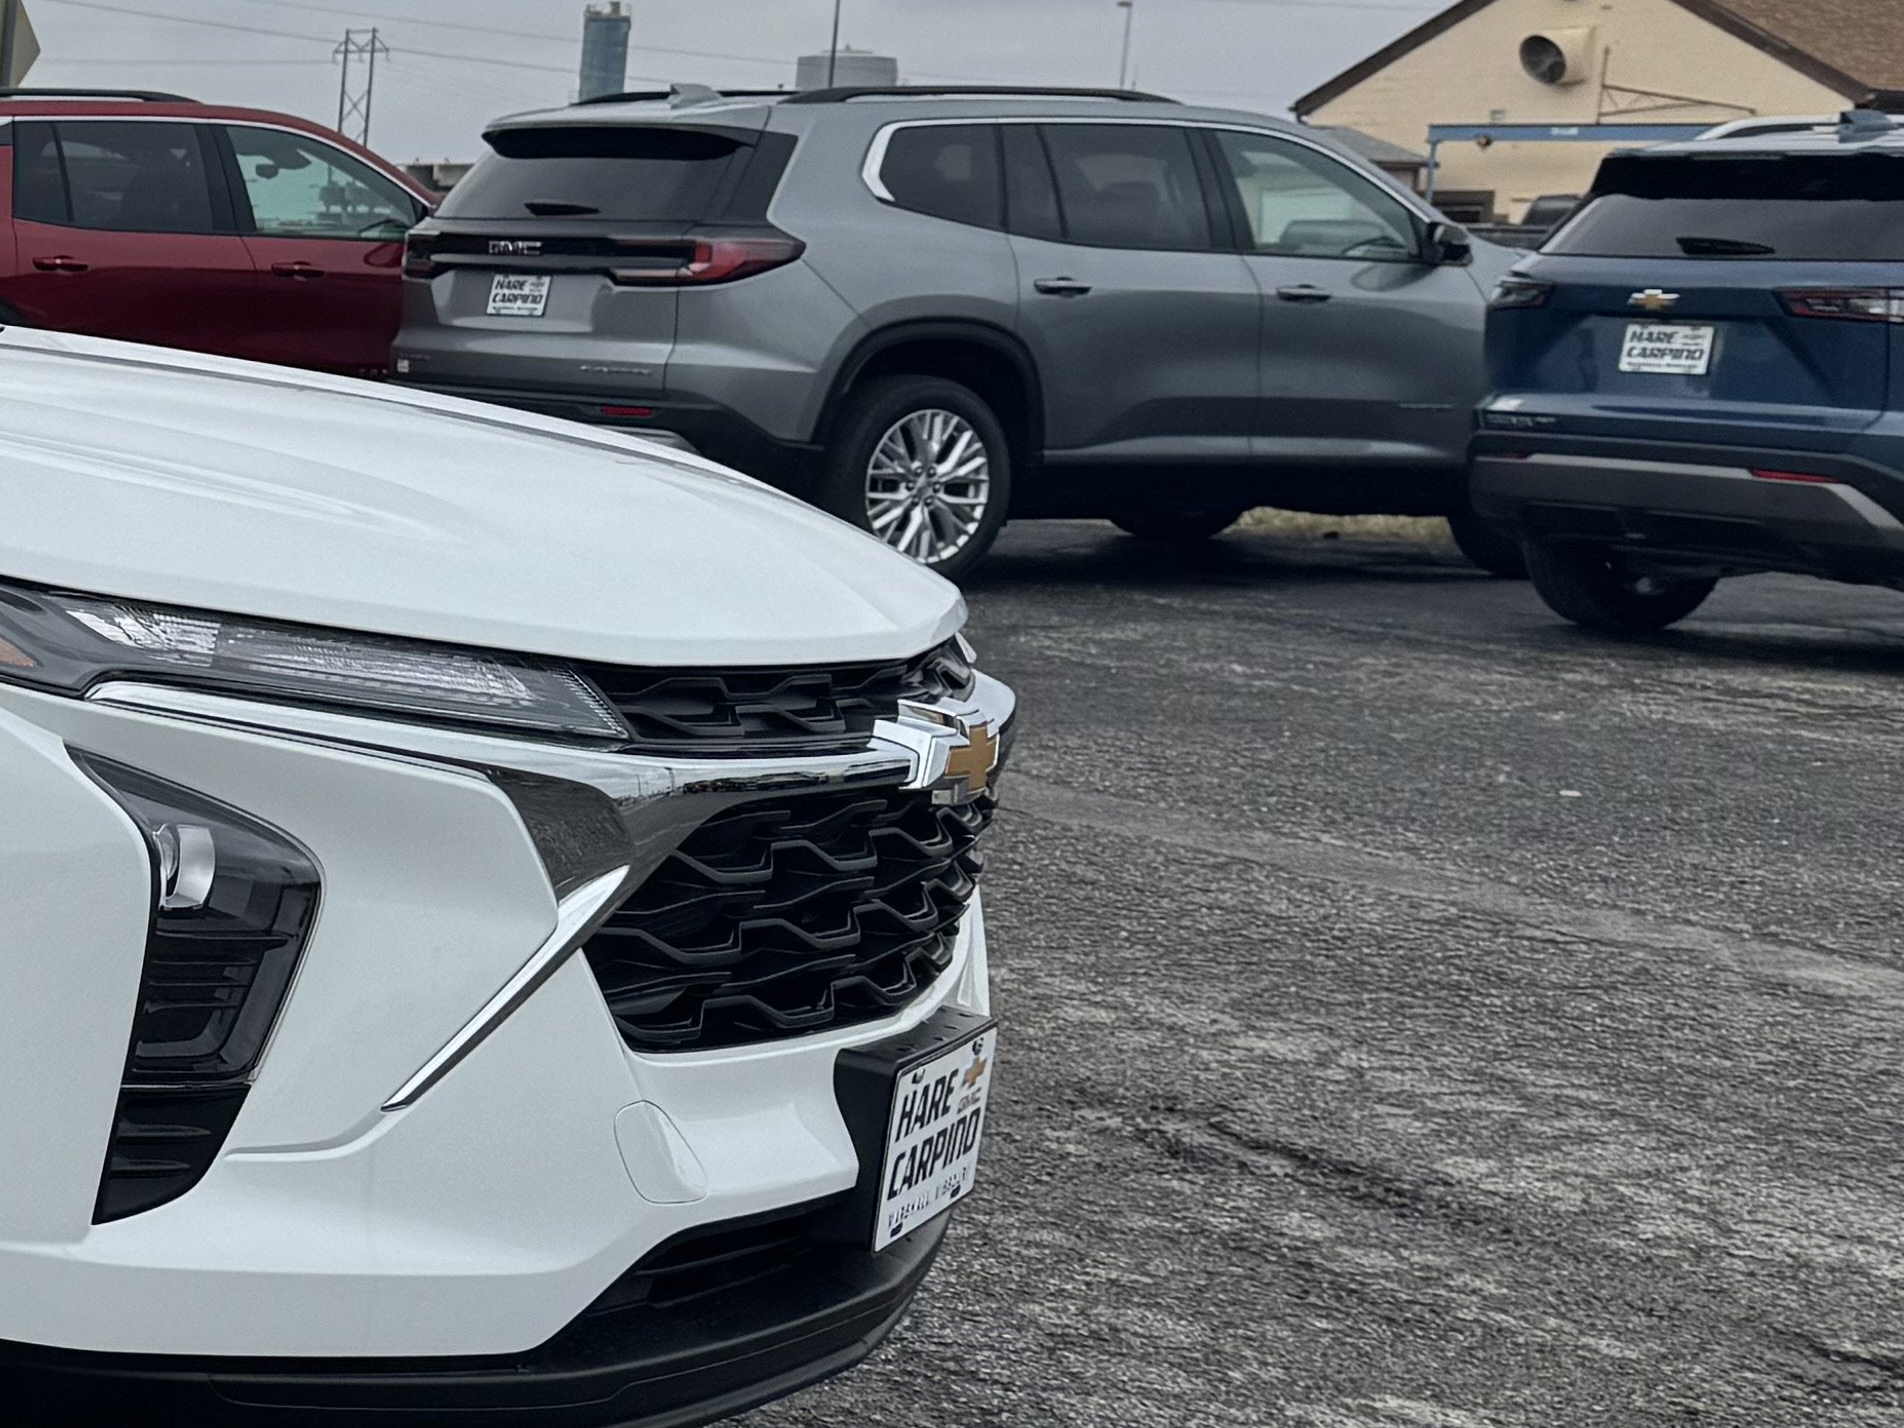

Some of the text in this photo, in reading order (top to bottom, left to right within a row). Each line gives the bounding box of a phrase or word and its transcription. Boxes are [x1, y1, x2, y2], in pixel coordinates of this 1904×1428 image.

[489, 240, 542, 255] GMC
[895, 1068, 959, 1143] HARE
[886, 1106, 981, 1201] CARPINO
